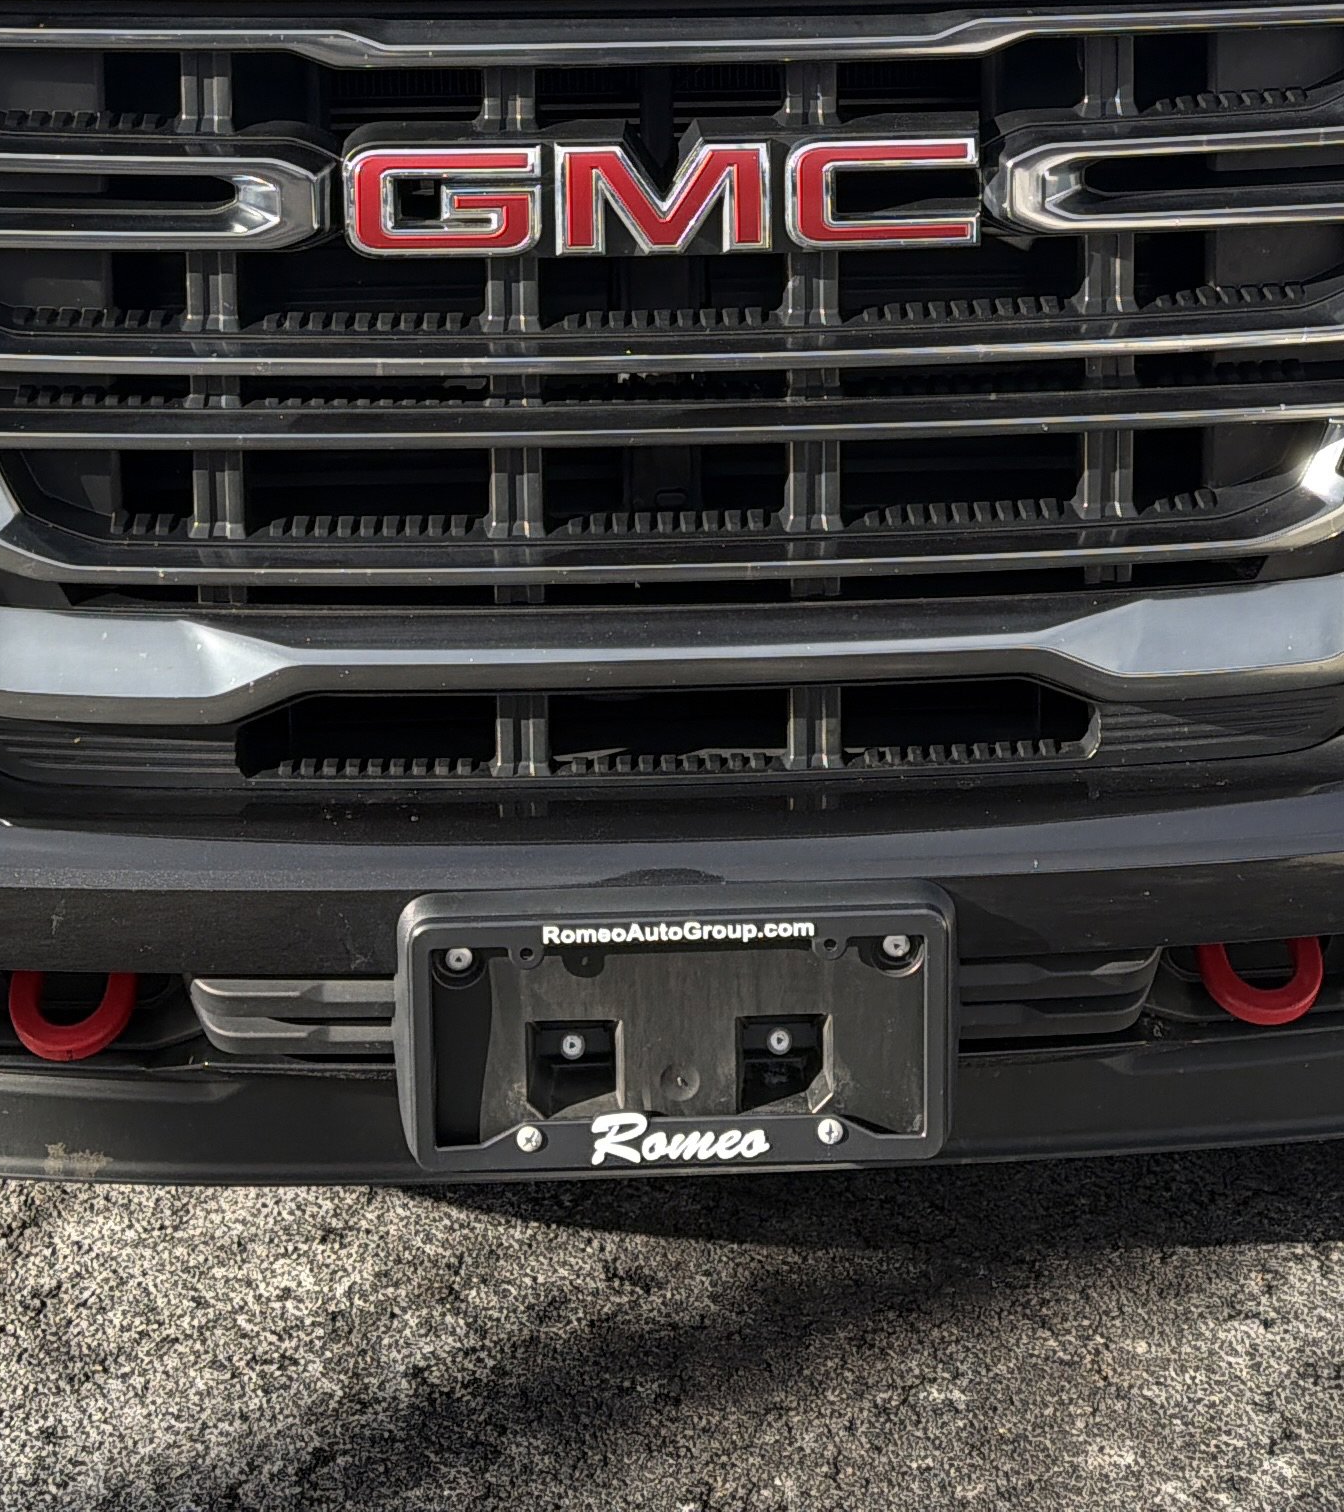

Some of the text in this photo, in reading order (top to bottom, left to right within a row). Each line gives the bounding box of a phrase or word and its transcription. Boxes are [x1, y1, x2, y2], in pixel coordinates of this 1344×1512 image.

[343, 137, 981, 258] GMC
[542, 921, 815, 945] RomeoAutoGroup.com
[590, 1111, 772, 1166] Romeo
